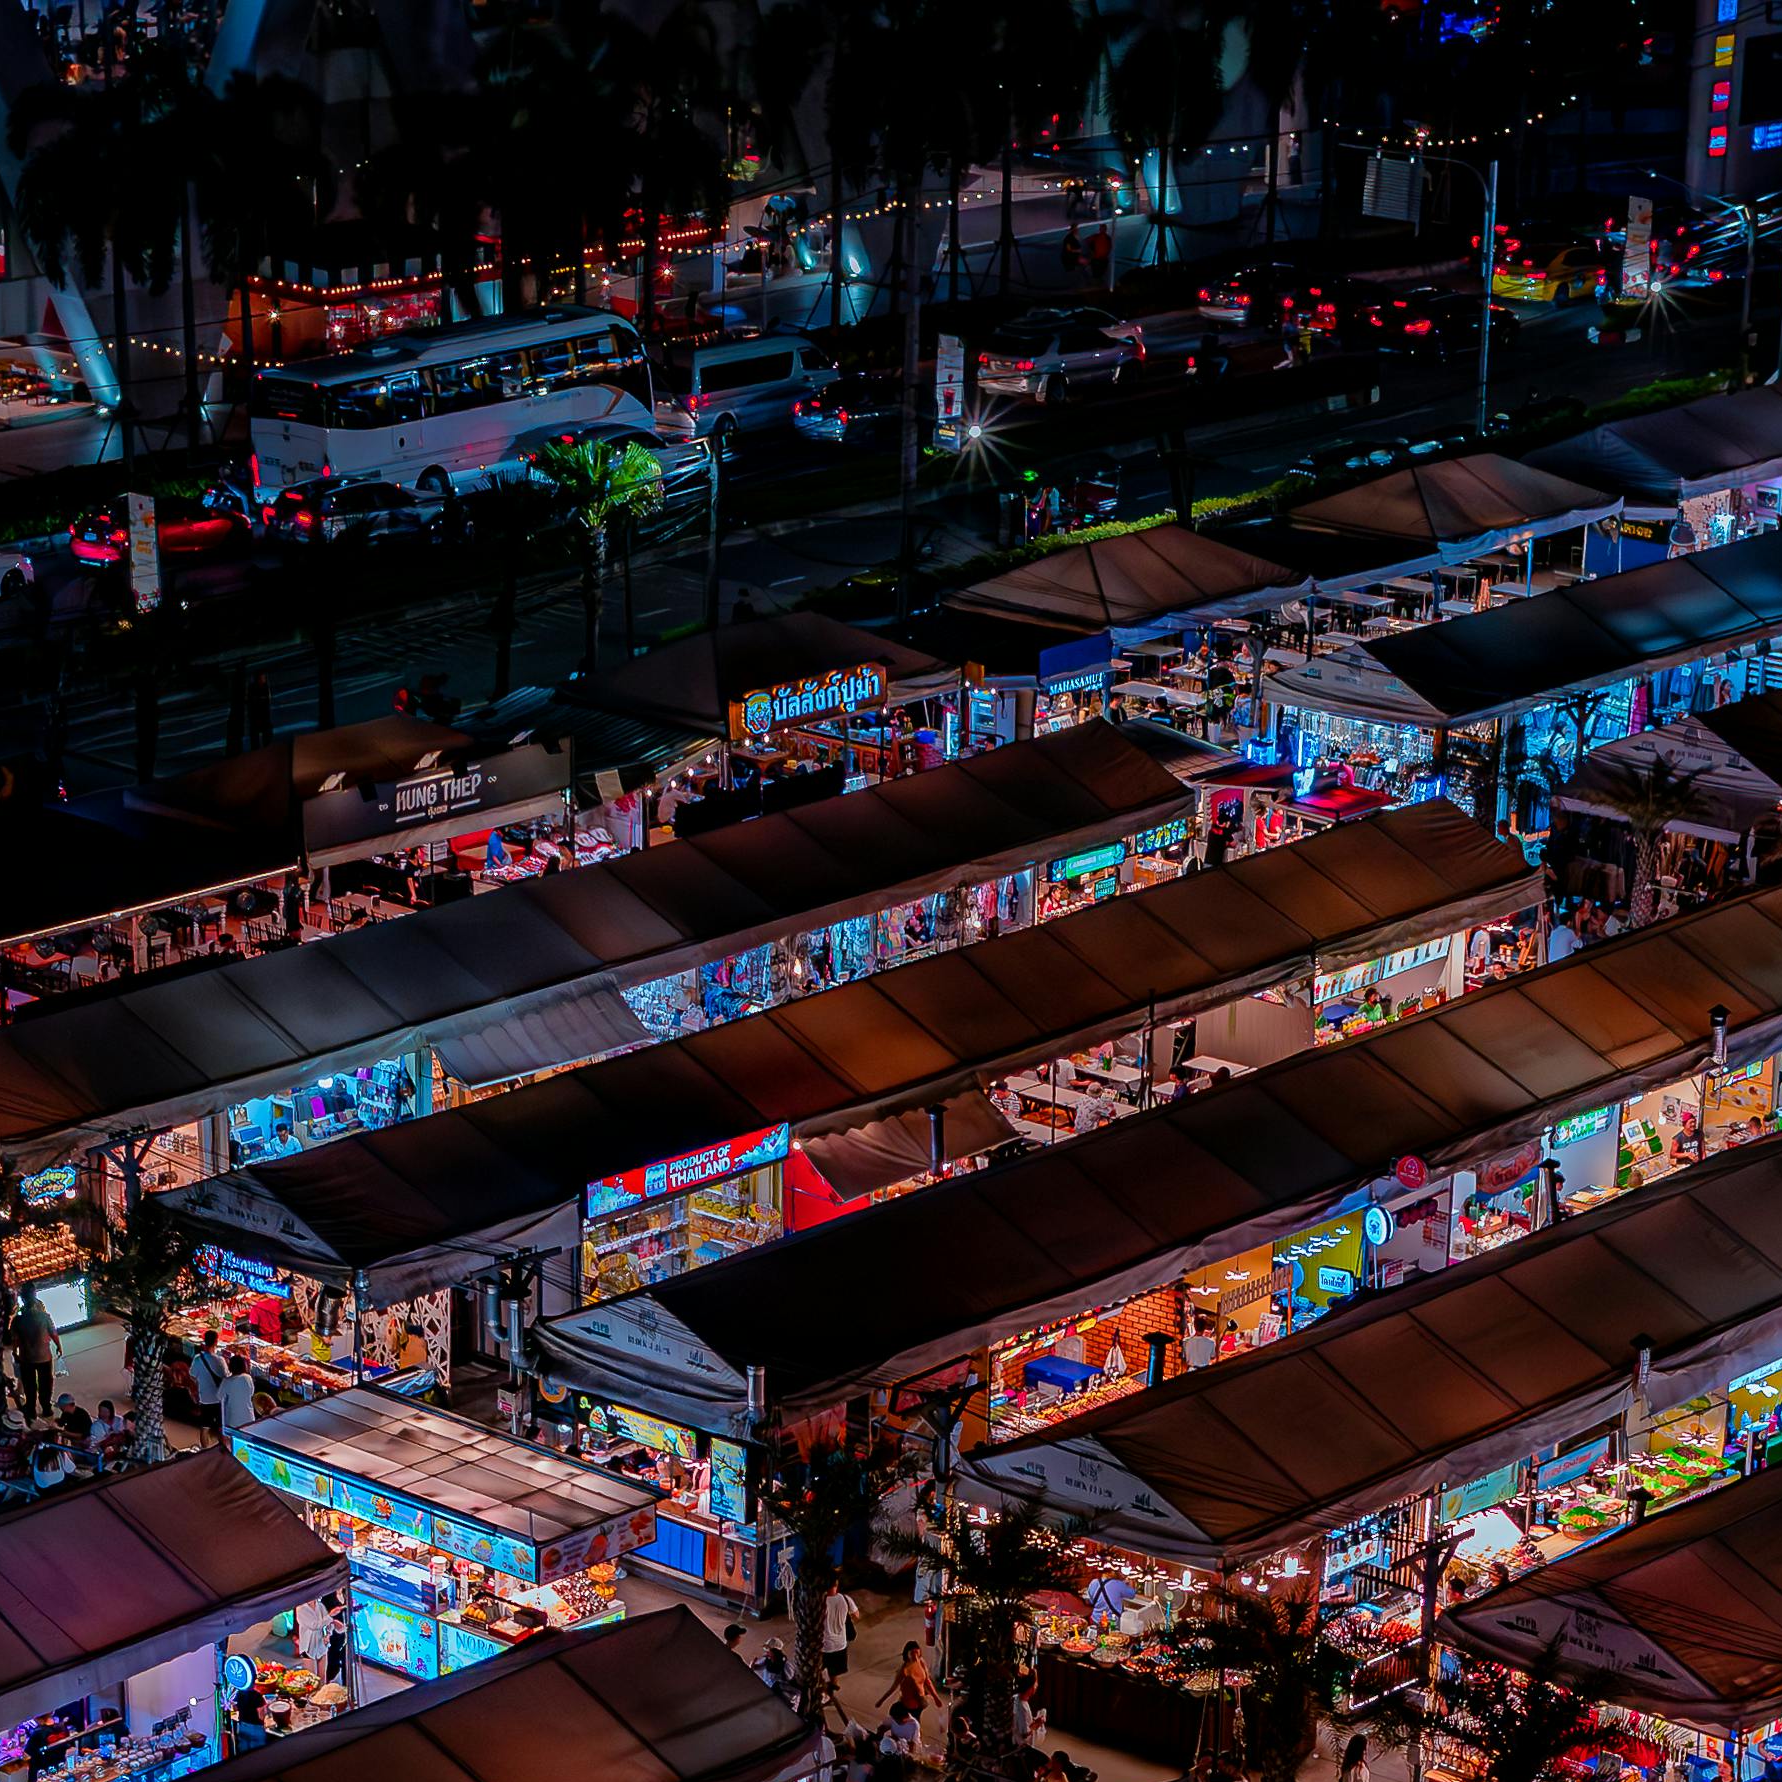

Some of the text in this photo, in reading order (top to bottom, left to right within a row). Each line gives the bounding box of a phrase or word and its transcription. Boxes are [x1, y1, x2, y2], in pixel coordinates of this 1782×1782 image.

[773, 668, 880, 722] บัลลังก์ปูม้า
[441, 773, 481, 801] THEP
[669, 1144, 731, 1173] PRODUCT OF
[670, 1159, 731, 1187] THAILAND
